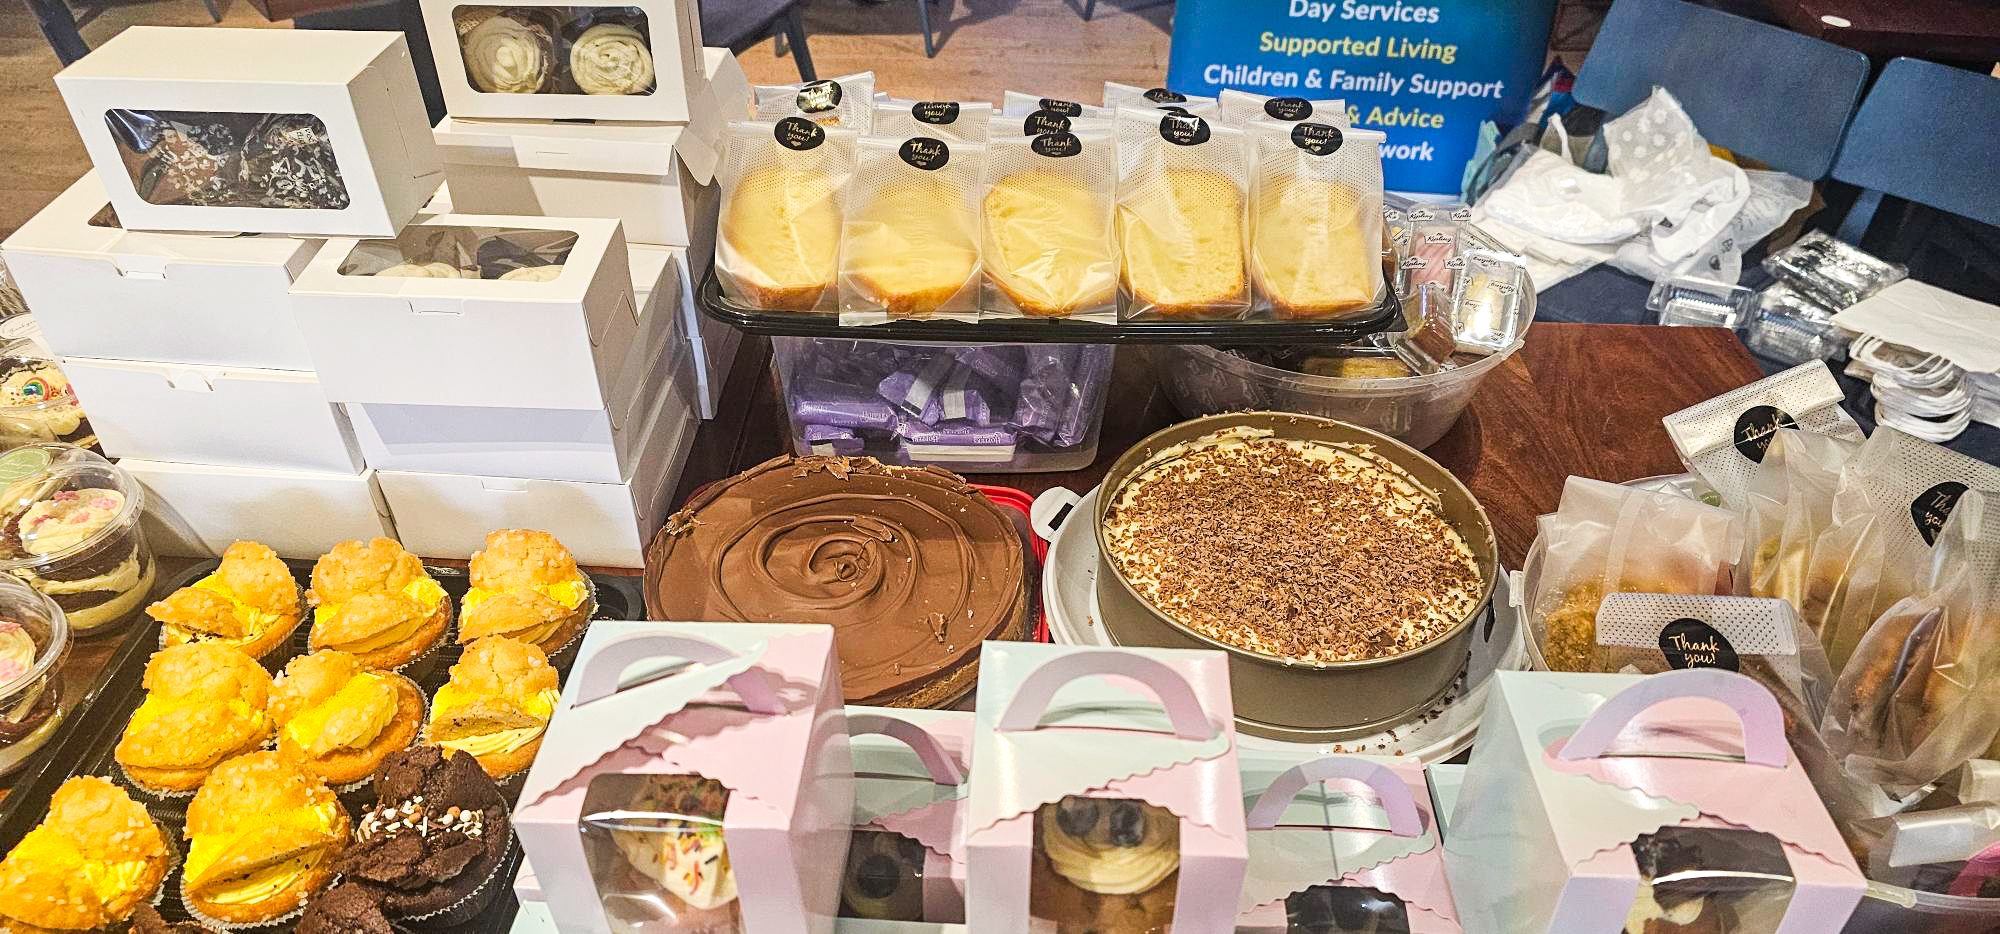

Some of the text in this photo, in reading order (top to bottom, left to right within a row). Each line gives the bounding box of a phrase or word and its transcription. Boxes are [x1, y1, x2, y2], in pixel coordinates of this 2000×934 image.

[1289, 0, 1440, 23] Day Services
[1260, 32, 1457, 63] Supported Living
[1204, 64, 1504, 99] Children & Family Support
[1035, 116, 1065, 129] Thank
[1365, 106, 1444, 128] Advice
[787, 122, 817, 137] Thank
[1173, 130, 1195, 138] you!
[1301, 126, 1334, 140] Thank
[910, 143, 941, 156] Thank
[1043, 137, 1072, 147] Thank
[1305, 138, 1327, 146] you!
[1741, 414, 1781, 441] Thank
[1931, 491, 1952, 515] Tha
[1668, 633, 1720, 653] Thank
[1685, 653, 1716, 671] you!
